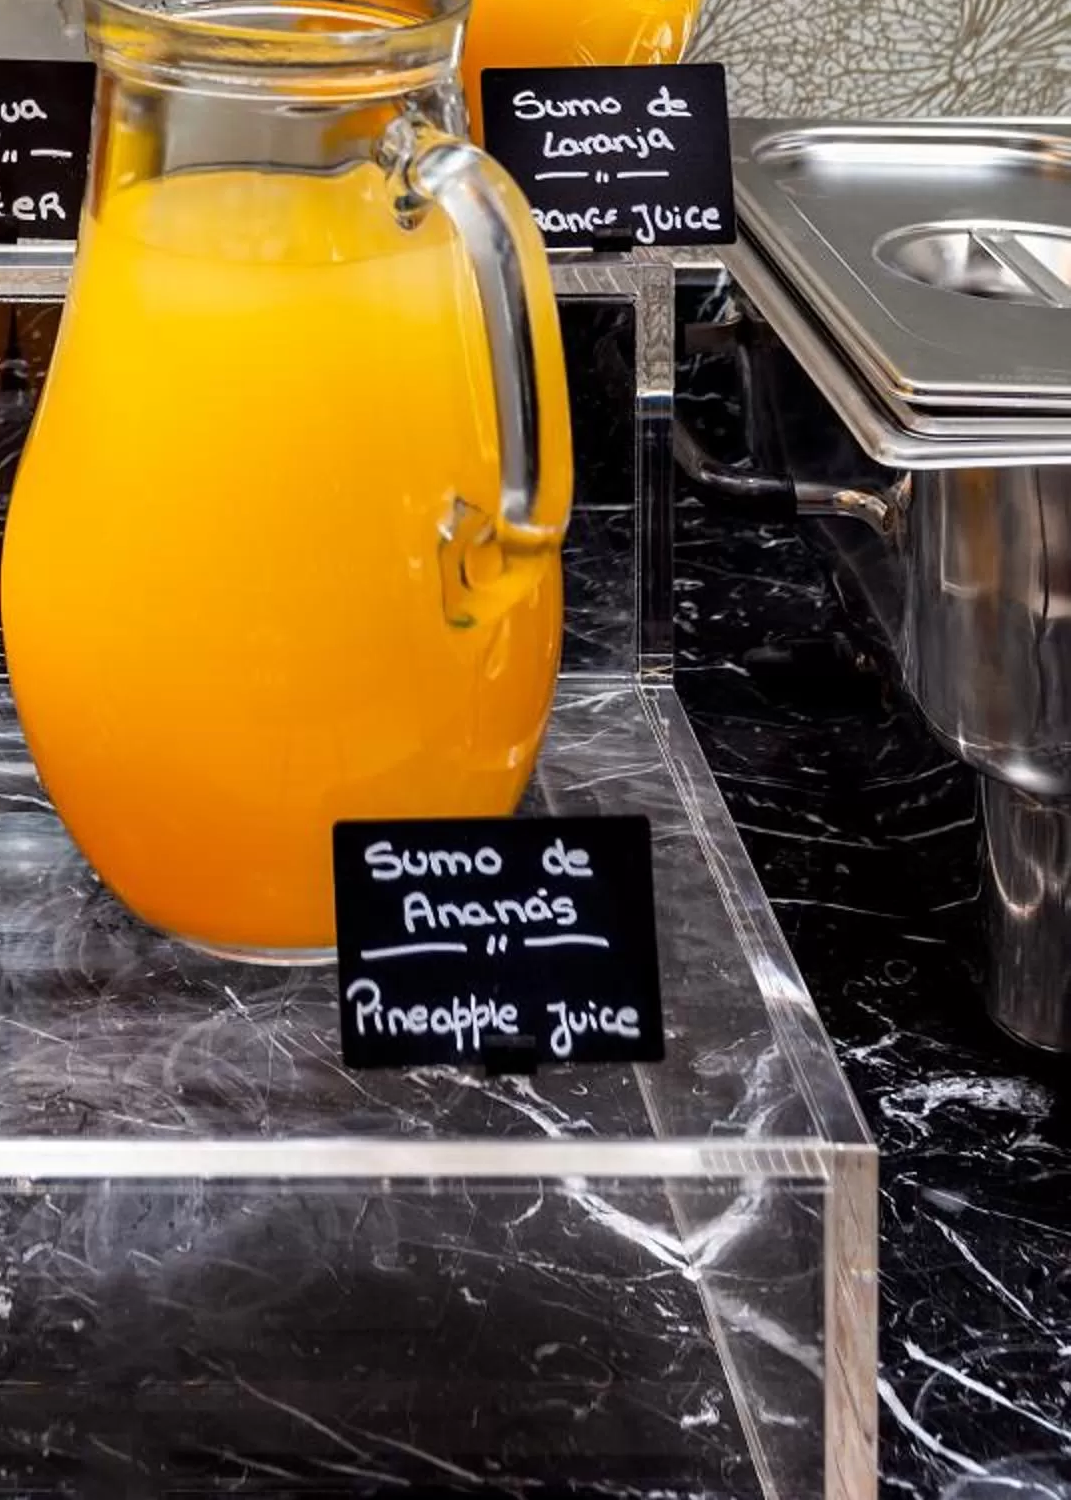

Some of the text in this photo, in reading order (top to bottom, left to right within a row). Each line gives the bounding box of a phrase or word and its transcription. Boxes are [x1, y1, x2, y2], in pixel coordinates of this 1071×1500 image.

[512, 85, 693, 120] Sumo de
[542, 127, 676, 159] Laranja
[630, 203, 722, 245] Juice
[364, 837, 594, 881] Sumo de
[402, 887, 578, 933] Ananás
[345, 977, 642, 1058] Pineapple Juice
